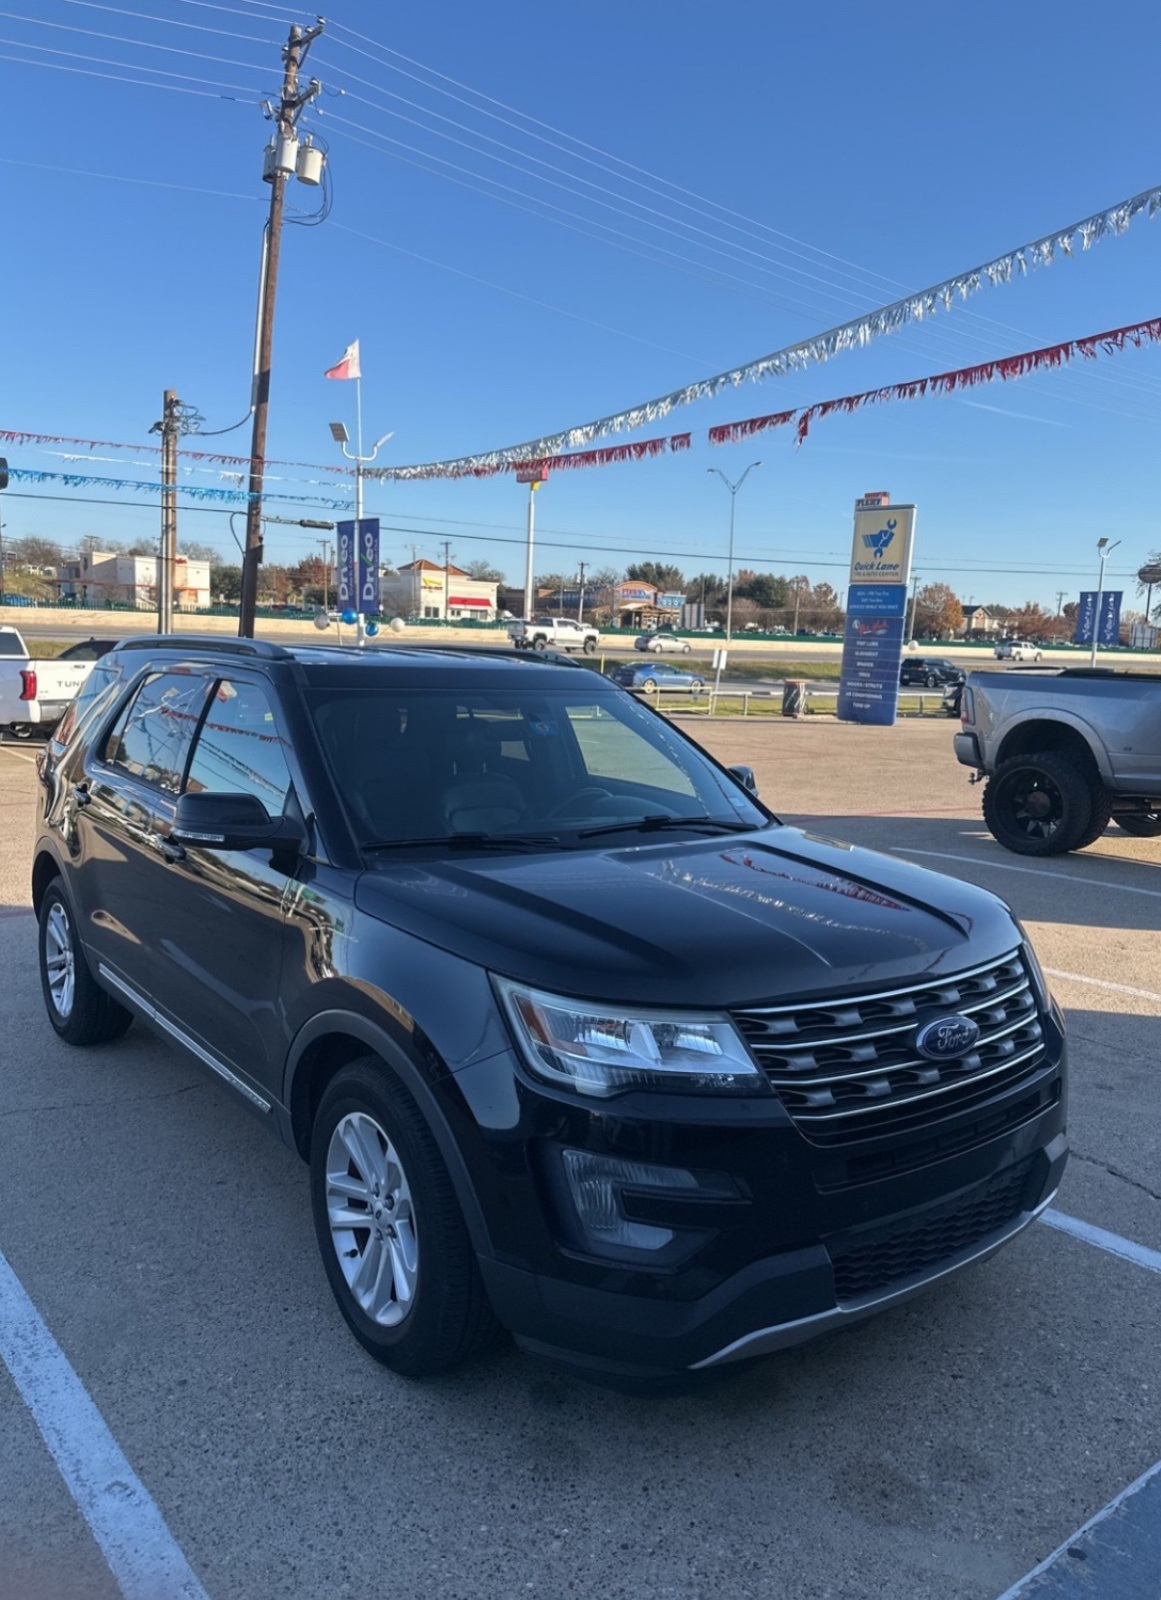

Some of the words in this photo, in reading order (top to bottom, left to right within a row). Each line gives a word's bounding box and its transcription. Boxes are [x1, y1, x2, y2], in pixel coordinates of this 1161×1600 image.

[361, 532, 374, 600] Driveo
[854, 561, 875, 571] Quick
[876, 561, 899, 571] Lane
[937, 1023, 970, 1051] Ford
